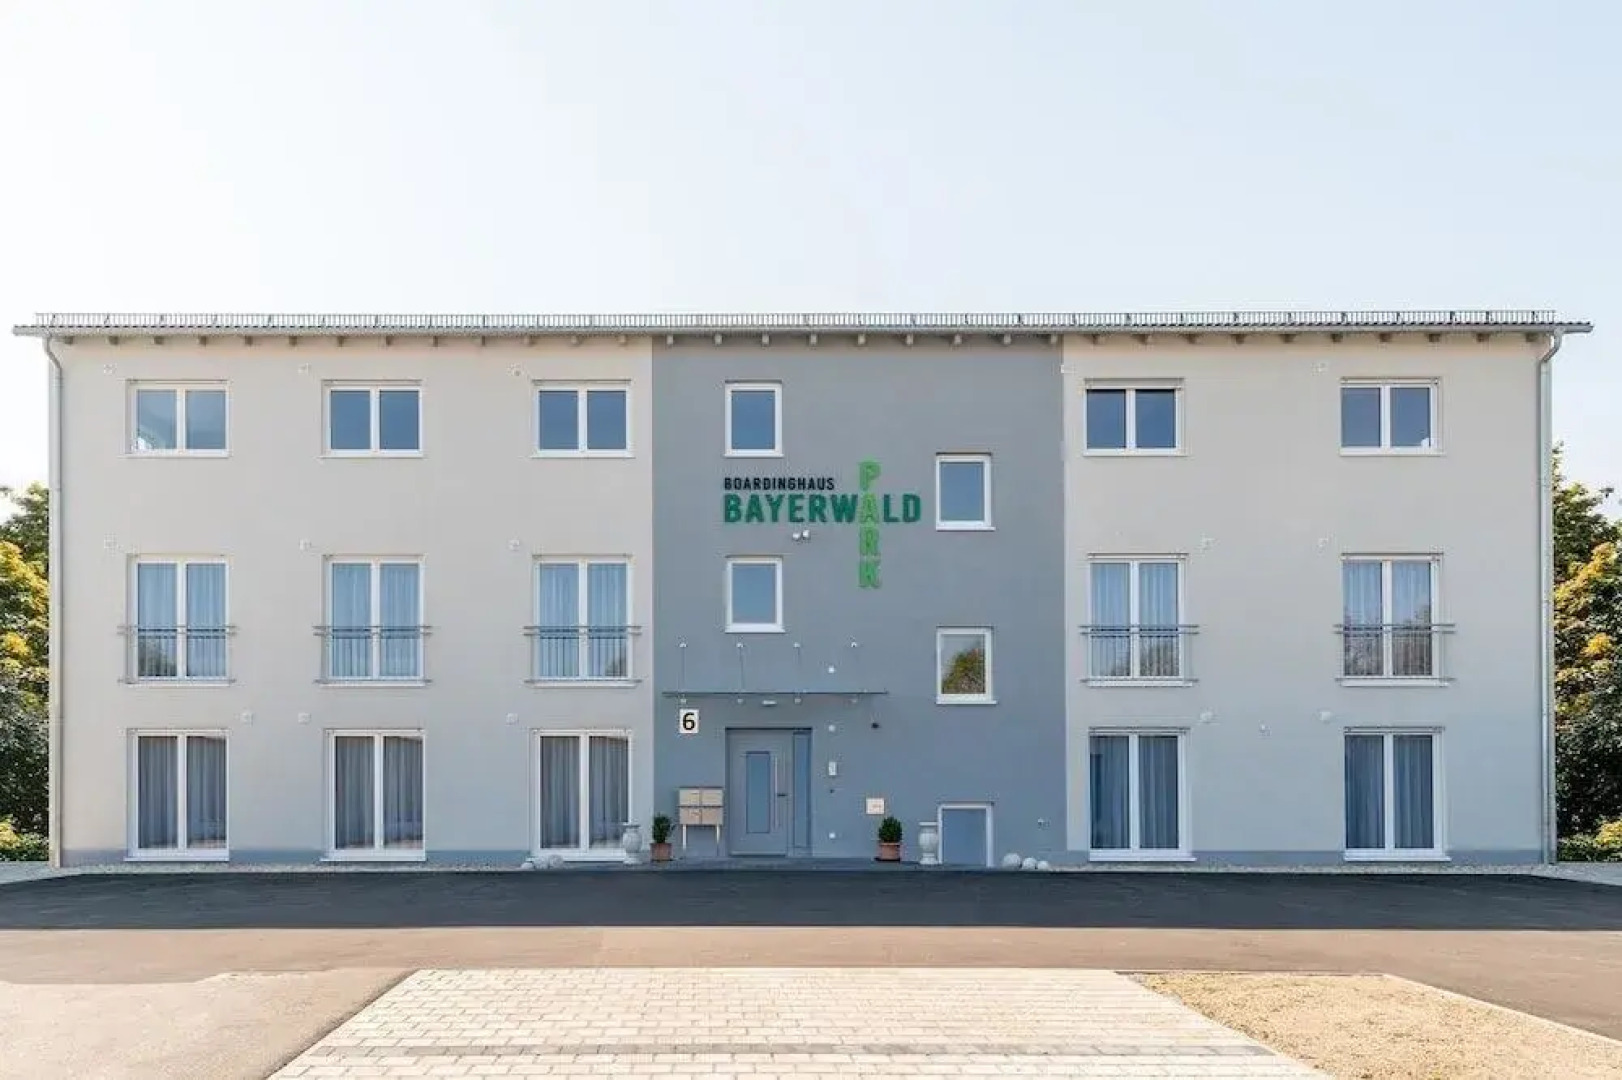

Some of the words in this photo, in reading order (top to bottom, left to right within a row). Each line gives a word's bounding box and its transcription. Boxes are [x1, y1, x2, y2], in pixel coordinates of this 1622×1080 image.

[724, 477, 835, 491] BOARDINGHAUS
[724, 494, 921, 523] BAYERWALD
[860, 461, 881, 588] PARK
[682, 712, 695, 730] 6
